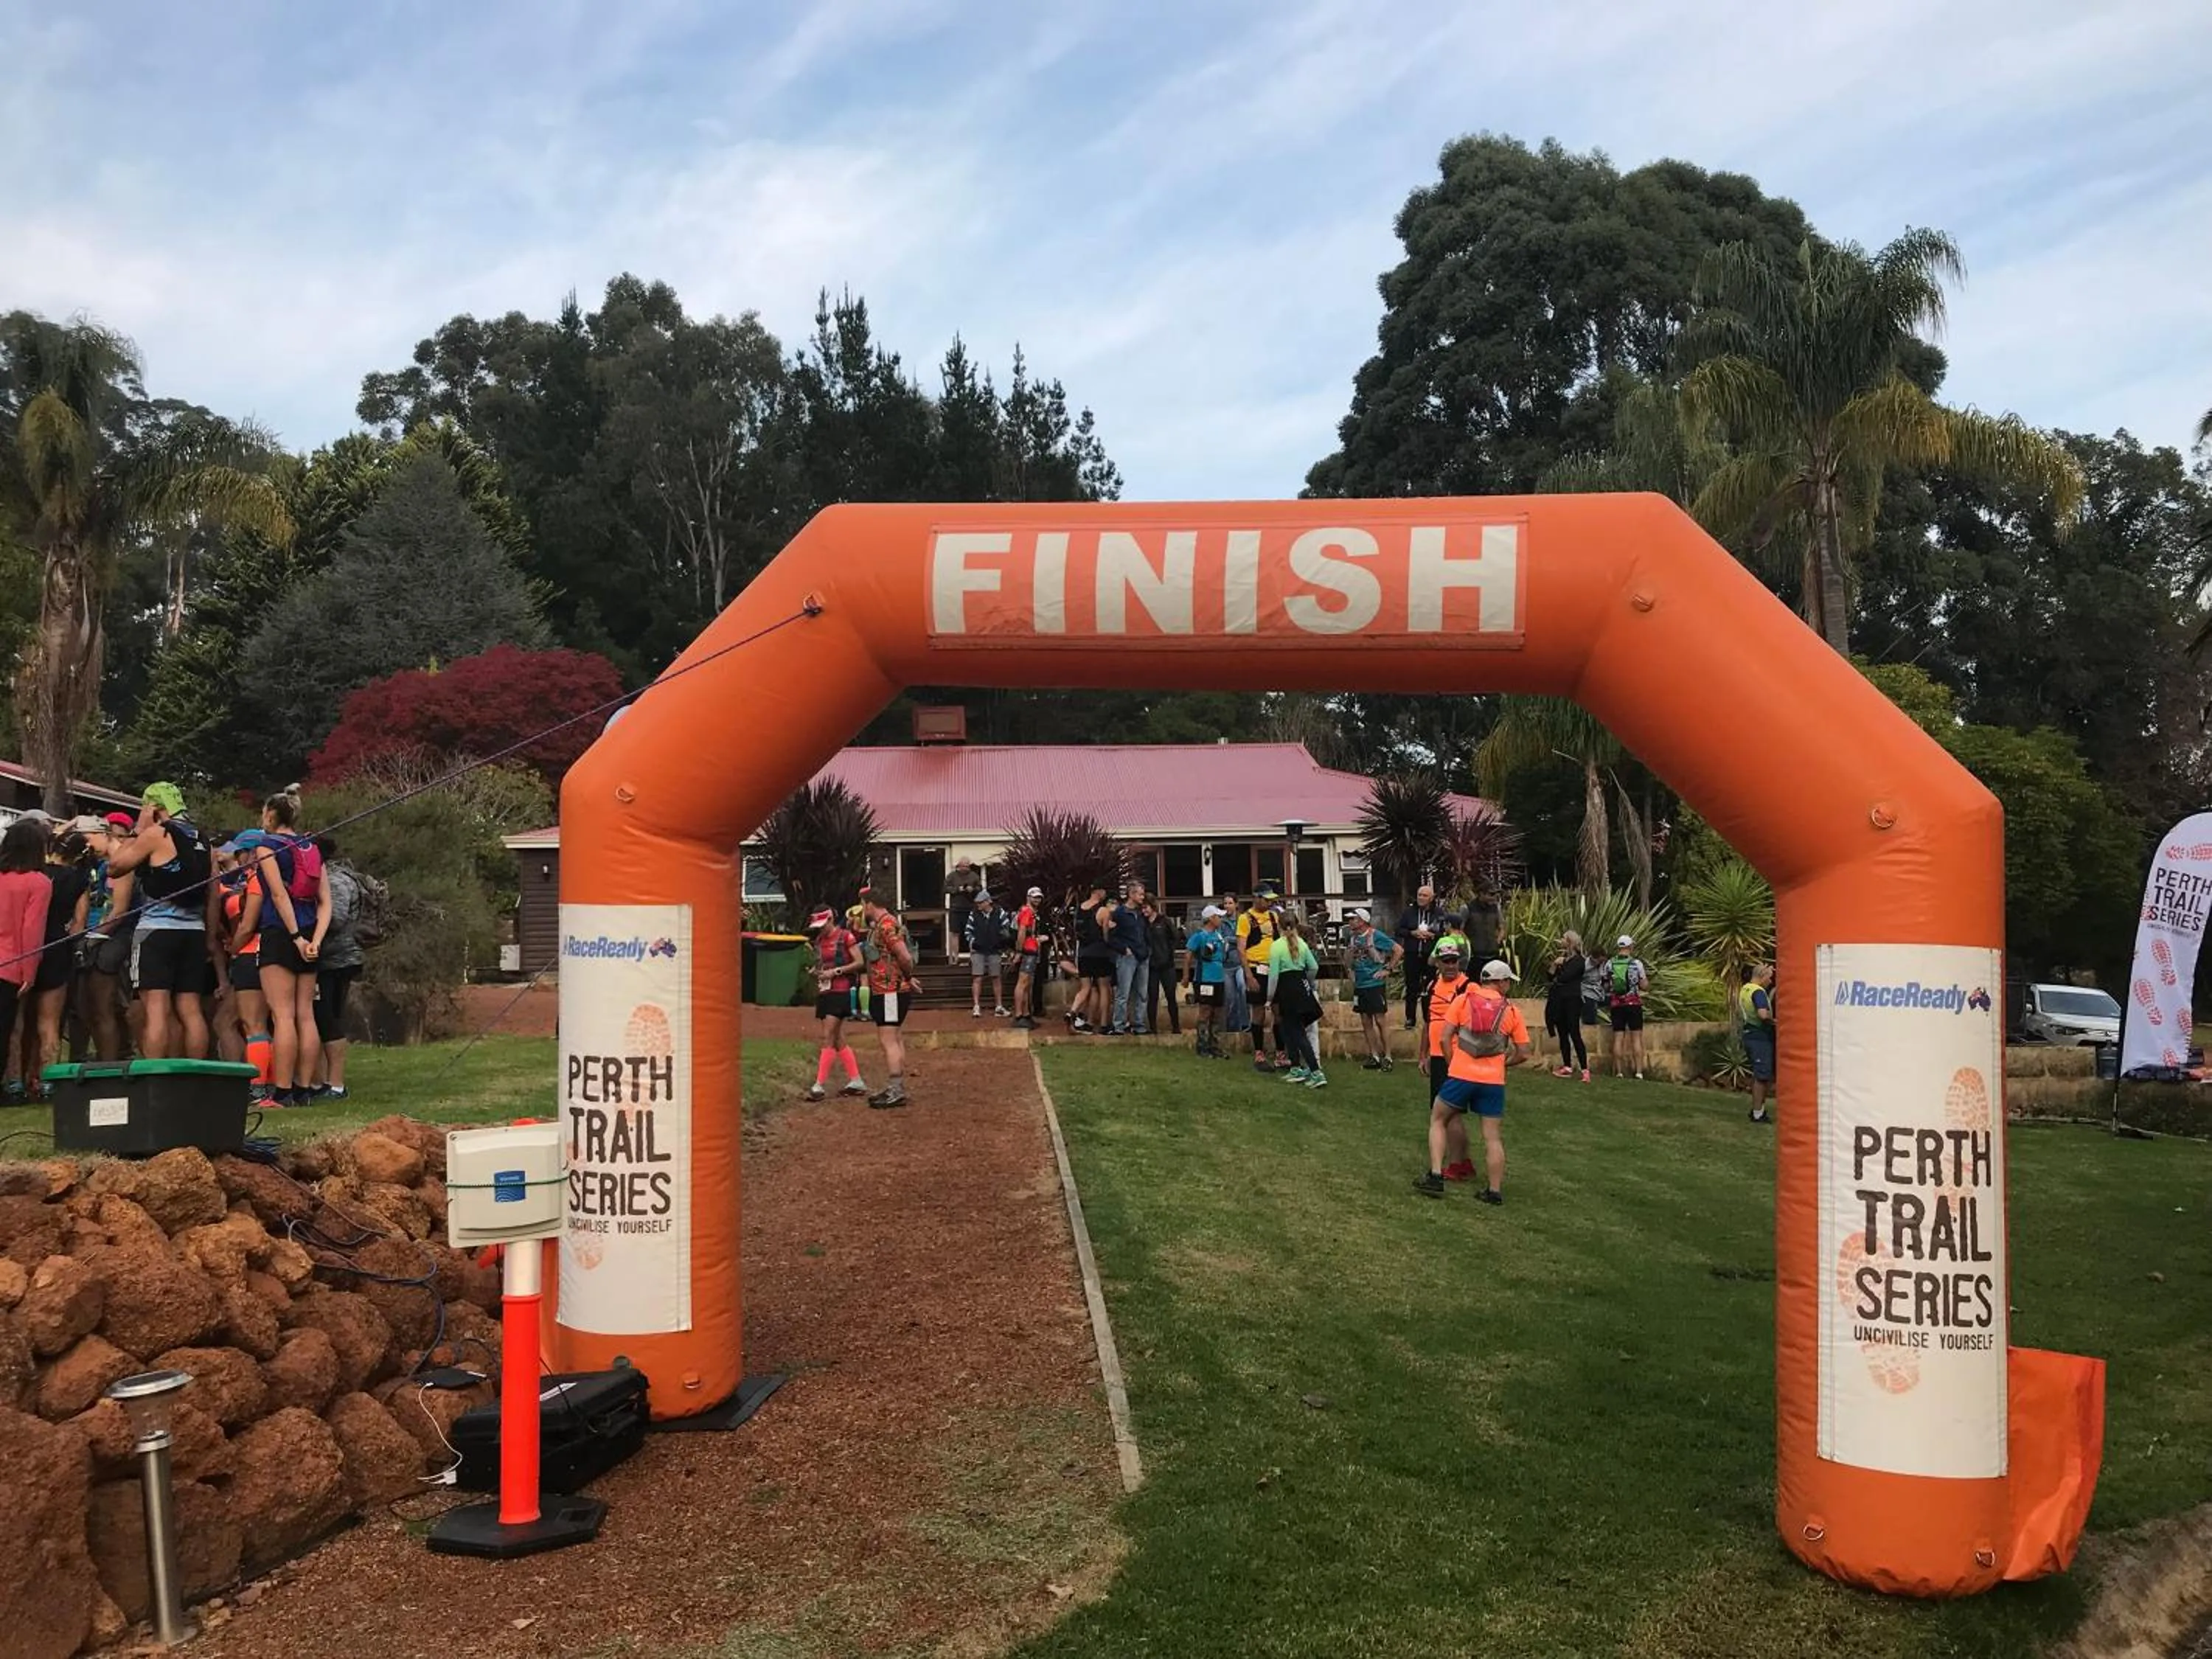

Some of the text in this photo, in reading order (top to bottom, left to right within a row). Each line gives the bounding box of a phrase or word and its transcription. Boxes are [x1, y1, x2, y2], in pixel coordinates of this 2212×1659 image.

[933, 526, 1518, 635] FINISH
[2154, 886, 2203, 915] TRAIL
[2155, 867, 2212, 895] PERTH
[2149, 905, 2201, 931] SERIES
[568, 936, 647, 961] RaceReady
[1850, 981, 1966, 1015] RaceReady
[568, 1054, 673, 1103] PERTH
[568, 1107, 671, 1164] TRAIL
[1854, 1126, 1991, 1186] PERTH
[568, 1169, 671, 1216] SERIES
[617, 1219, 672, 1234] YOURSELF
[1856, 1189, 1992, 1262] TRAIL
[1855, 1267, 1992, 1328] SERIES
[1854, 1325, 1994, 1350] UNCIVILISE YOURSELF
